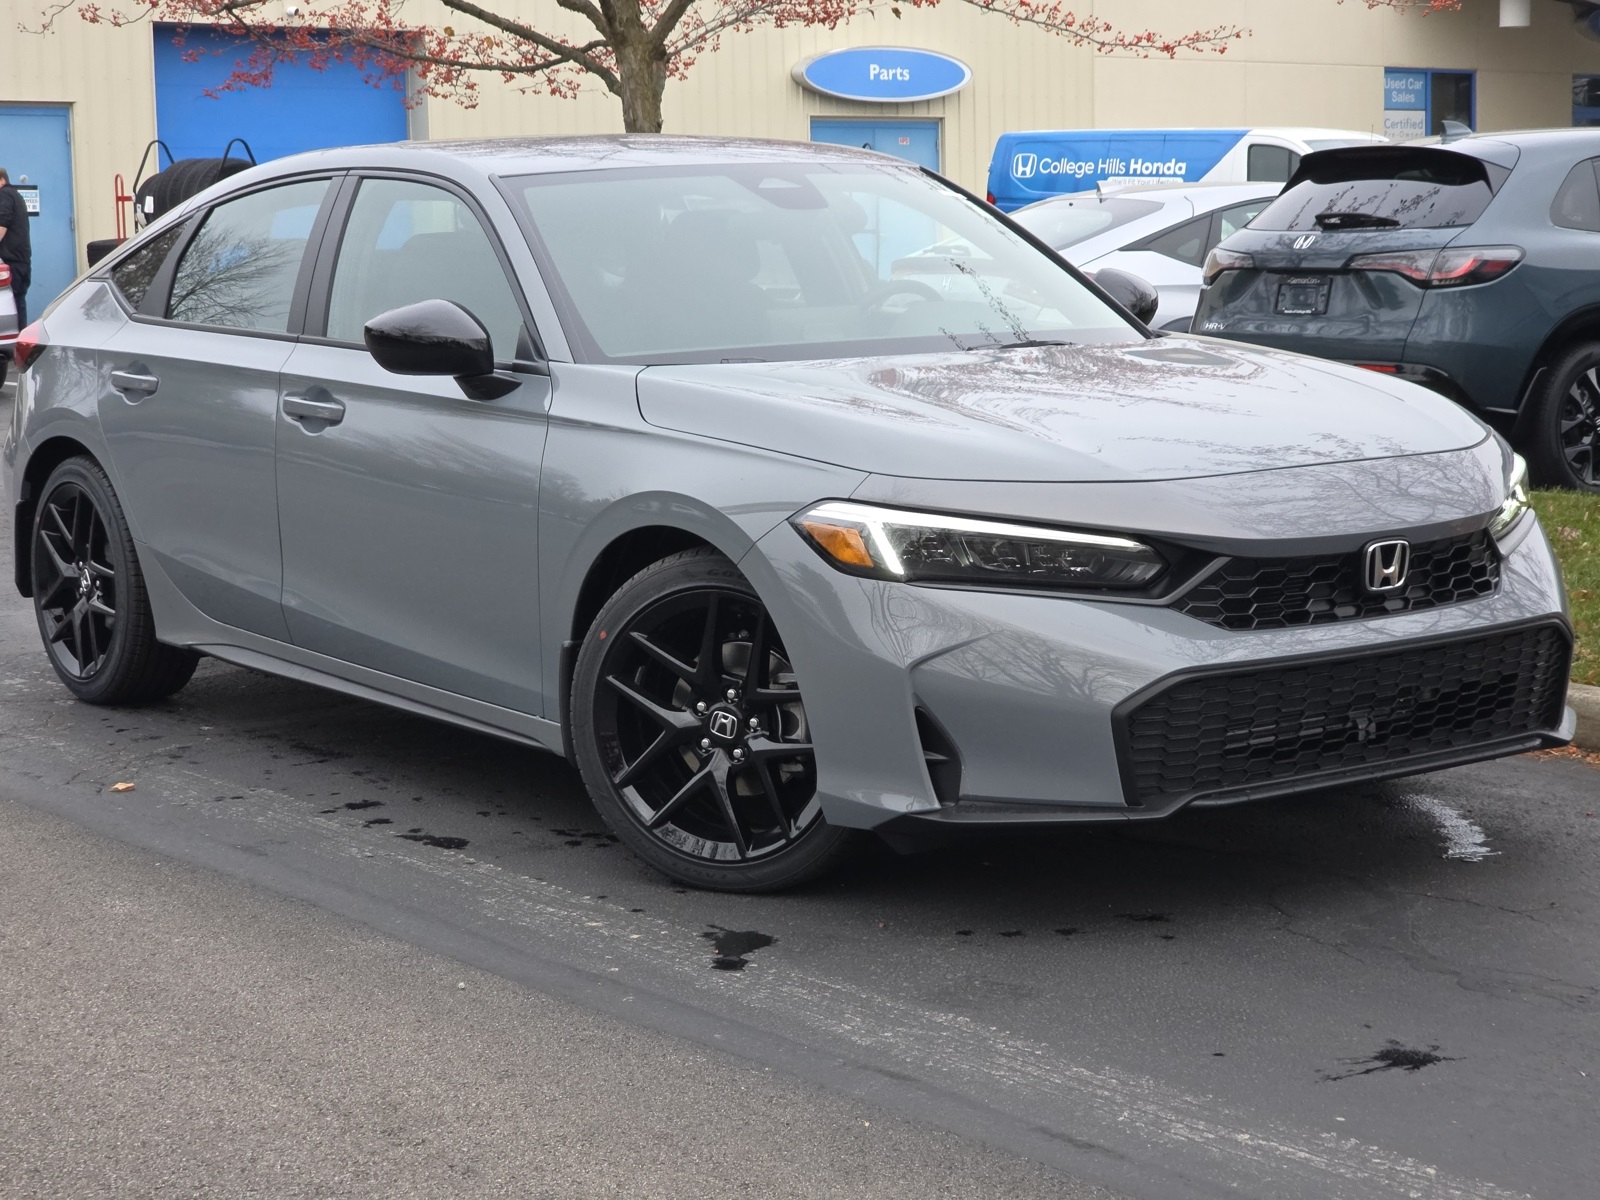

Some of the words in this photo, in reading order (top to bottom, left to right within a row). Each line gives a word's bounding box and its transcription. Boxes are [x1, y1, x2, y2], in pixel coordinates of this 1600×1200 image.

[869, 63, 910, 81] Parts
[1384, 77, 1406, 89] Used
[1407, 78, 1424, 90] Car
[1391, 90, 1416, 103] Sales
[1384, 117, 1424, 130] Certified
[1039, 157, 1095, 178] College
[1097, 158, 1126, 175] Hills
[1129, 158, 1187, 175] Honda
[1205, 322, 1228, 330] HR-V
